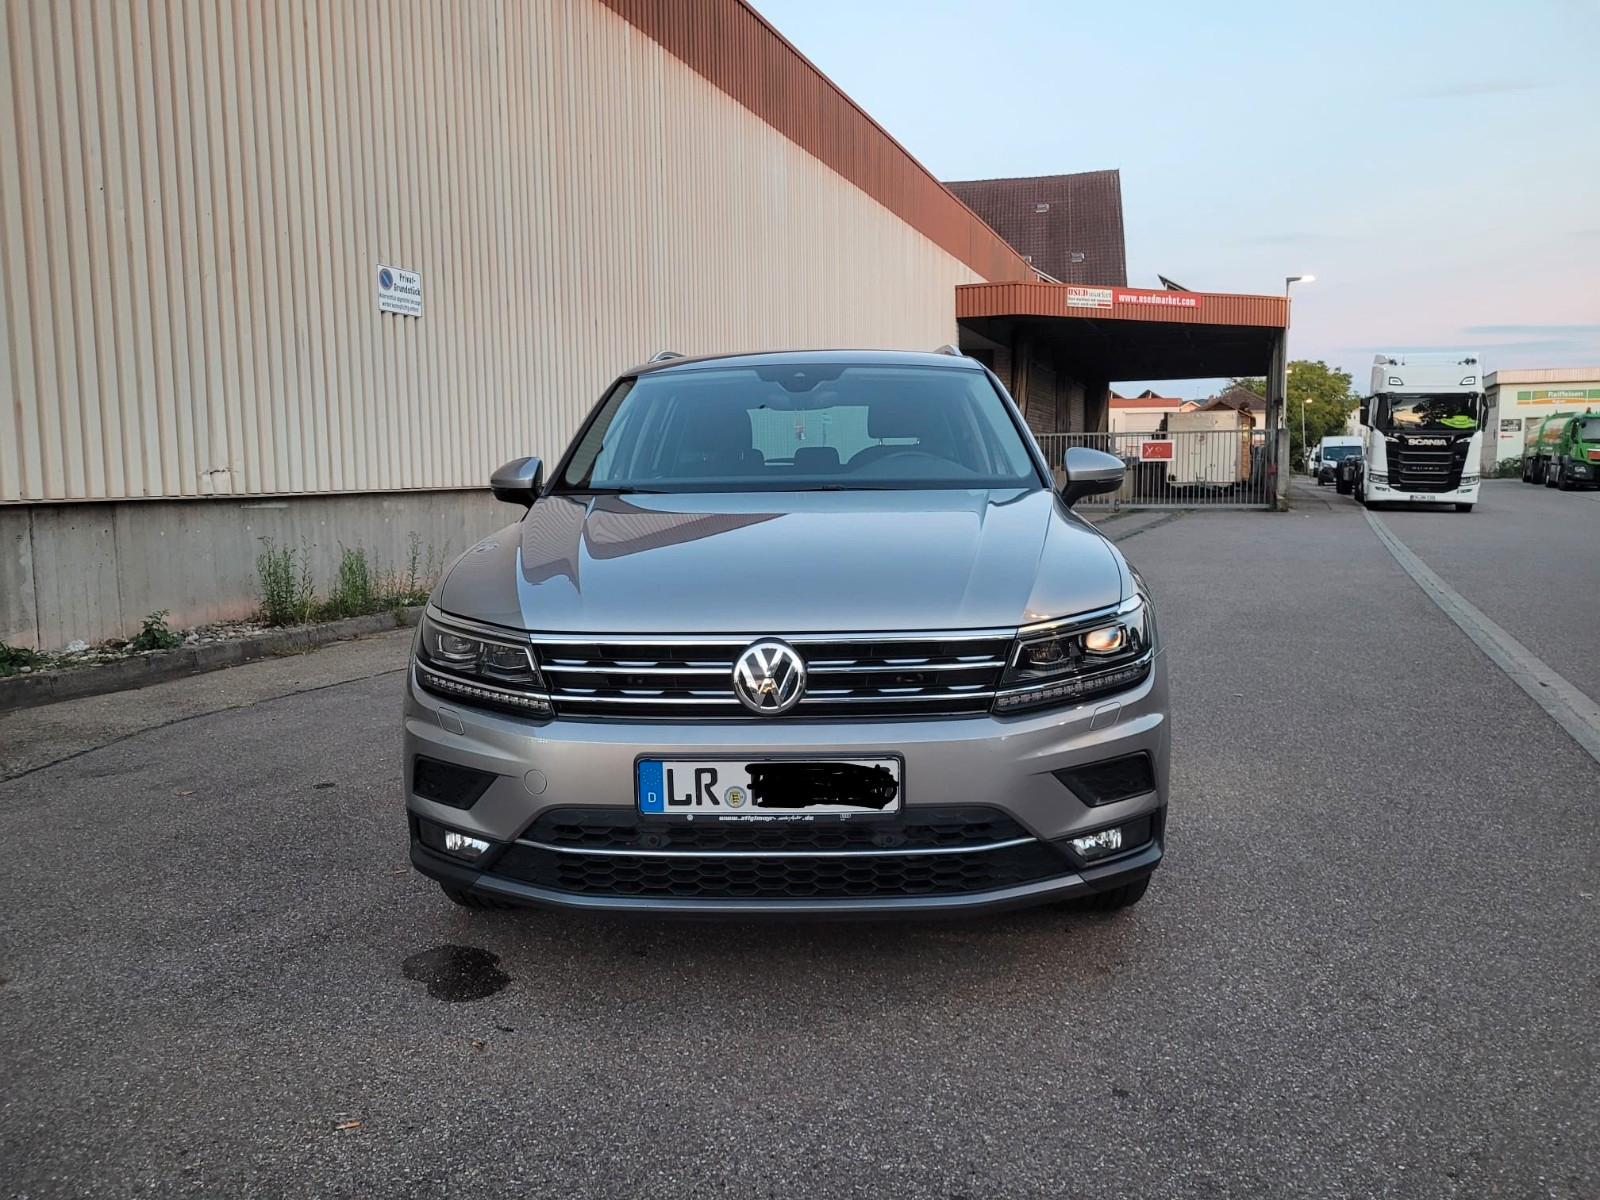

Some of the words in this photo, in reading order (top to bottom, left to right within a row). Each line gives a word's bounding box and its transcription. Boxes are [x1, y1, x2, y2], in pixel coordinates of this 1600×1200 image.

[1118, 294, 1196, 306] www.usedmarket.com
[667, 768, 720, 806] LR
[647, 792, 657, 803] D
